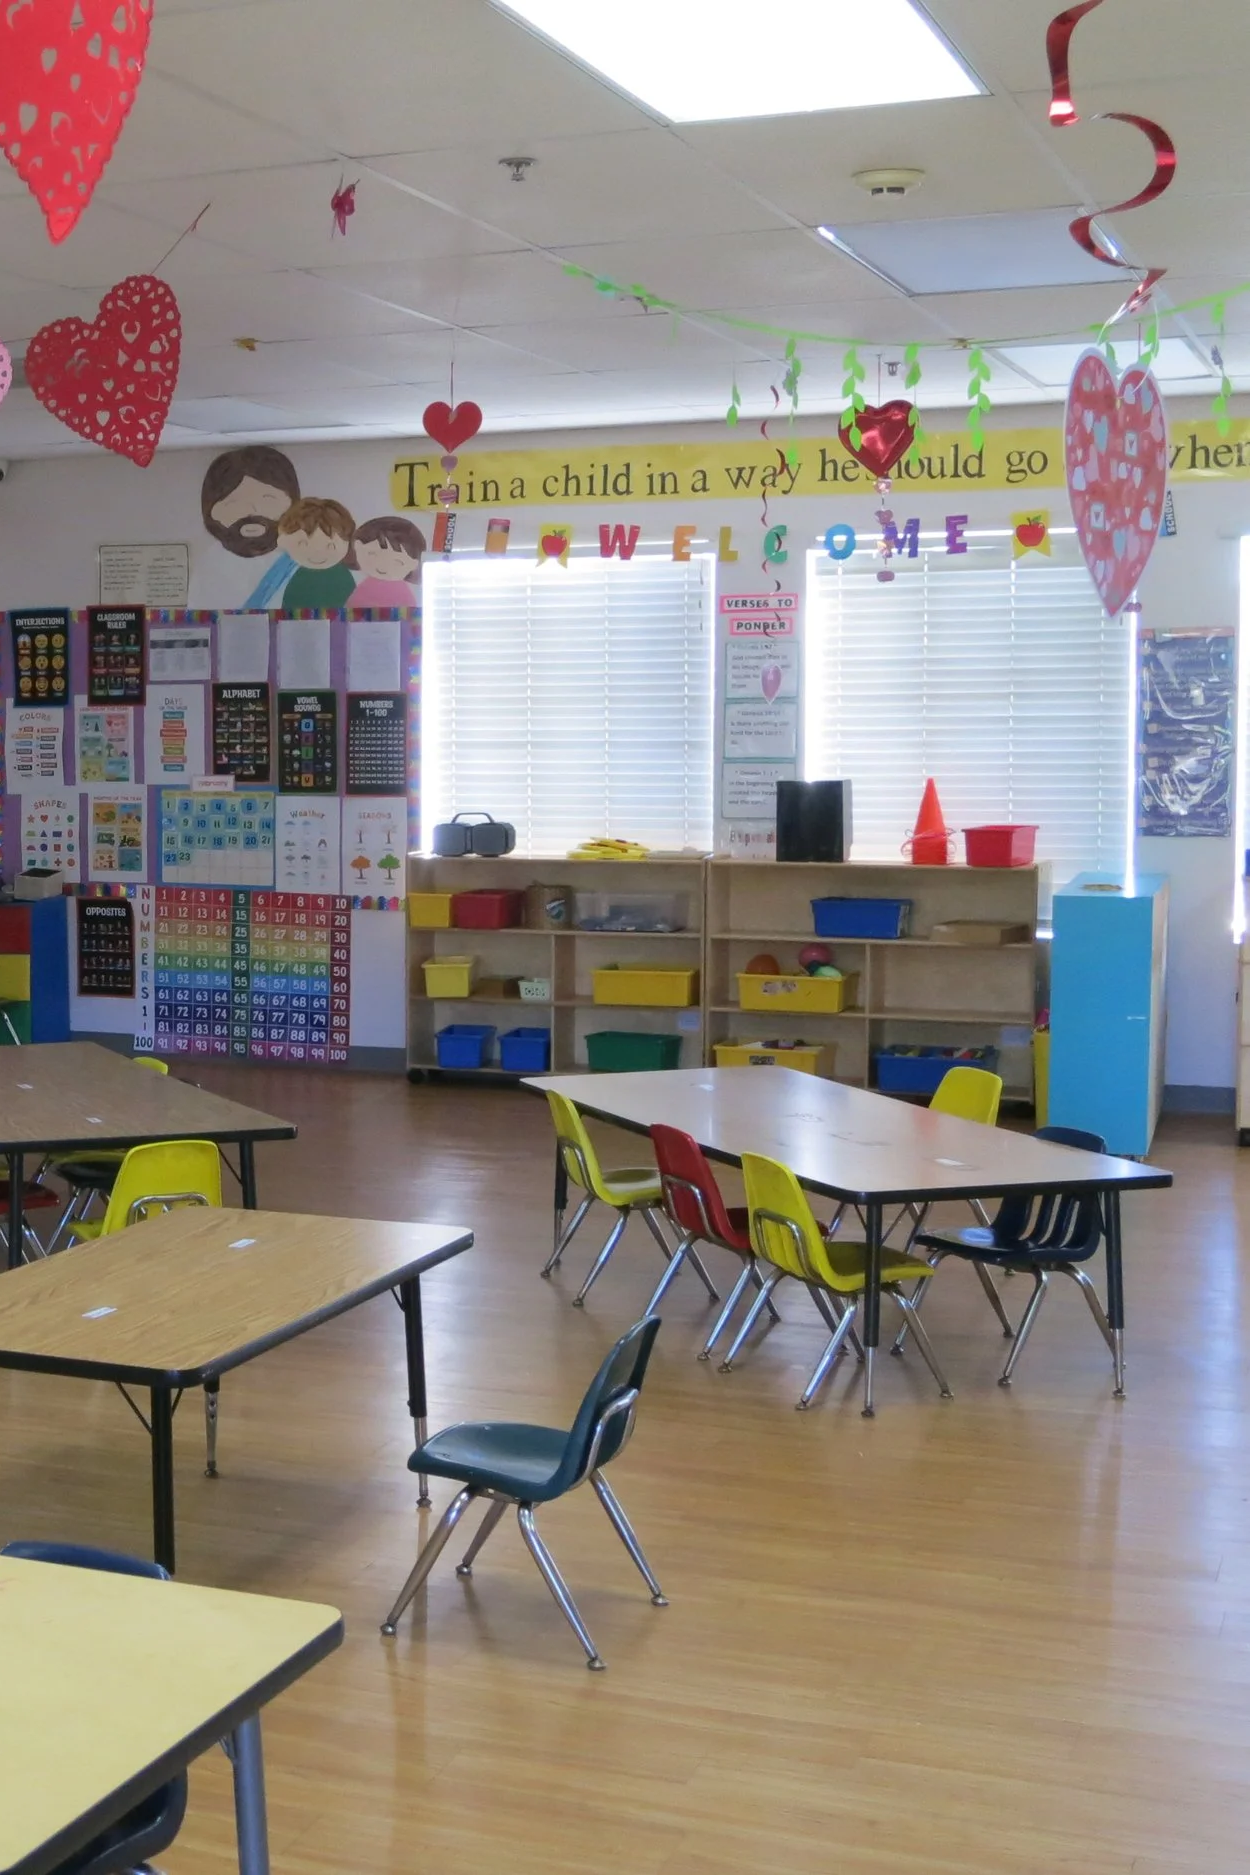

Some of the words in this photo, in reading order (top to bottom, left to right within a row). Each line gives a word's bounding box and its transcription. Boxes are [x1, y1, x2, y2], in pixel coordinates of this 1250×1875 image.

[509, 476, 526, 499] a
[542, 462, 633, 497] child
[646, 463, 680, 496] in
[690, 469, 710, 493] a
[725, 463, 802, 495] way
[817, 448, 860, 482] he
[866, 443, 986, 481] ould
[1005, 449, 1048, 483] go
[726, 599, 769, 608] VERSES
[777, 598, 793, 607] TO
[15, 617, 65, 626] INTERJECTIONS
[96, 612, 136, 621] CLASSROOM
[106, 621, 127, 629] RULES
[736, 621, 786, 630] PONDER
[222, 689, 261, 698] ALPHABET
[296, 696, 318, 704] VOWEL
[359, 700, 394, 709] NUMBERS
[294, 704, 321, 712] SOUNDS
[365, 709, 388, 717] 1-100
[19, 712, 52, 722] COLORS
[33, 800, 68, 810] SHAPES
[167, 801, 170, 809] 1
[183, 802, 189, 811] 2
[200, 804, 206, 812] 3
[215, 803, 222, 811] 4
[230, 804, 236, 812] 5
[263, 802, 269, 810] 7
[289, 809, 325, 819] Weather
[358, 811, 392, 820] SEASONS
[183, 818, 189, 827] 9
[197, 820, 207, 828] 10
[214, 820, 221, 828] 11
[227, 817, 237, 825] 12
[243, 821, 253, 829] 13
[261, 821, 271, 829] 14
[166, 836, 175, 845] 15
[184, 836, 193, 844] 16
[197, 836, 207, 845] 17
[213, 837, 222, 846] 18
[228, 836, 238, 844] 19
[245, 837, 257, 845] 20
[261, 836, 271, 844] 21
[178, 852, 191, 861] 23
[163, 890, 166, 899] 1
[181, 891, 186, 900] 2
[200, 891, 205, 901] 3
[219, 893, 225, 902] 4
[239, 894, 245, 903] 5
[258, 895, 264, 905] 6
[278, 896, 283, 905] 7
[297, 896, 304, 907] 8
[318, 898, 324, 908] 9
[336, 899, 346, 909] 10
[85, 907, 126, 917] OPPOSITES
[160, 906, 168, 916] 11
[179, 907, 188, 917] 12
[198, 908, 207, 918] 13
[216, 909, 227, 919] 14
[236, 910, 246, 920] 15
[256, 911, 266, 921] 16
[275, 913, 286, 922] 17
[295, 913, 306, 924] 18
[316, 915, 326, 924] 19
[335, 915, 347, 926] 20
[159, 989, 169, 999] 61
[177, 990, 189, 1000] 62
[196, 991, 208, 1001] 63
[215, 992, 227, 1002] 64
[234, 993, 247, 1003] 65
[253, 994, 265, 1005] 66
[273, 995, 286, 1005] 67
[291, 995, 306, 1007] 68
[313, 998, 326, 1008] 69
[334, 999, 346, 1010] 70
[159, 1005, 168, 1015] 71
[178, 1007, 188, 1016] 72
[196, 1007, 207, 1017] 73
[215, 1008, 227, 1019] 74
[235, 1010, 246, 1020] 75
[253, 1011, 264, 1021] 76
[272, 1012, 285, 1022] 77
[293, 1013, 305, 1024] 78
[313, 1015, 325, 1025] 79
[333, 1016, 346, 1026] 80
[158, 1021, 169, 1032] 81
[177, 1023, 189, 1033] 82
[196, 1024, 208, 1034] 83
[215, 1025, 228, 1035] 84
[234, 1026, 246, 1036] 85
[252, 1028, 264, 1038] 86
[271, 1029, 284, 1039] 87
[291, 1030, 305, 1041] 88
[312, 1031, 326, 1042] 89
[333, 1033, 345, 1044] 90
[135, 1036, 153, 1048] 100
[158, 1038, 168, 1048] 91
[176, 1039, 188, 1049] 92
[196, 1040, 207, 1051] 93
[214, 1041, 226, 1052] 94
[234, 1043, 245, 1053] 95
[251, 1044, 263, 1055] 96
[271, 1046, 283, 1056] 97
[291, 1047, 304, 1058] 98
[312, 1048, 324, 1059] 99
[329, 1048, 346, 1060] 100
